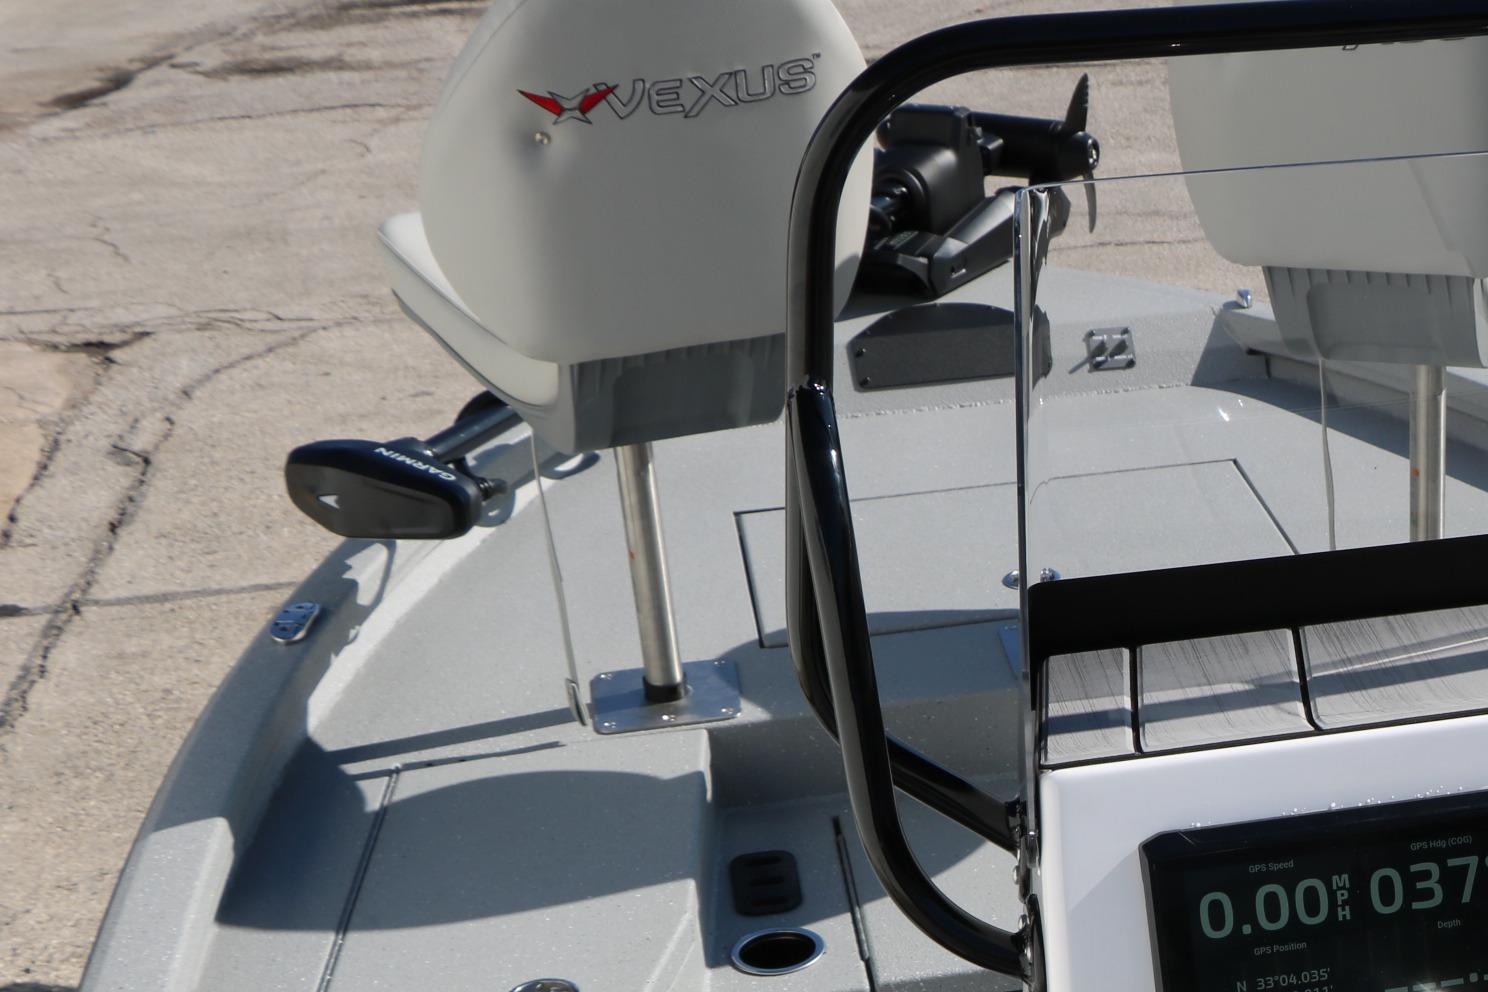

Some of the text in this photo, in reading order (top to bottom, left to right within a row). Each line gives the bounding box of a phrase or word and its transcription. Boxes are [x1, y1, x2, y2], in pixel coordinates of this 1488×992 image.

[1410, 842, 1427, 851] GPS
[1430, 840, 1446, 848] Hdg
[1249, 859, 1293, 872] GPS Speed
[1200, 878, 1328, 938] 0.00
[1438, 918, 1460, 928] Depth
[1254, 942, 1307, 955] GPS Position
[1236, 981, 1247, 992] N
